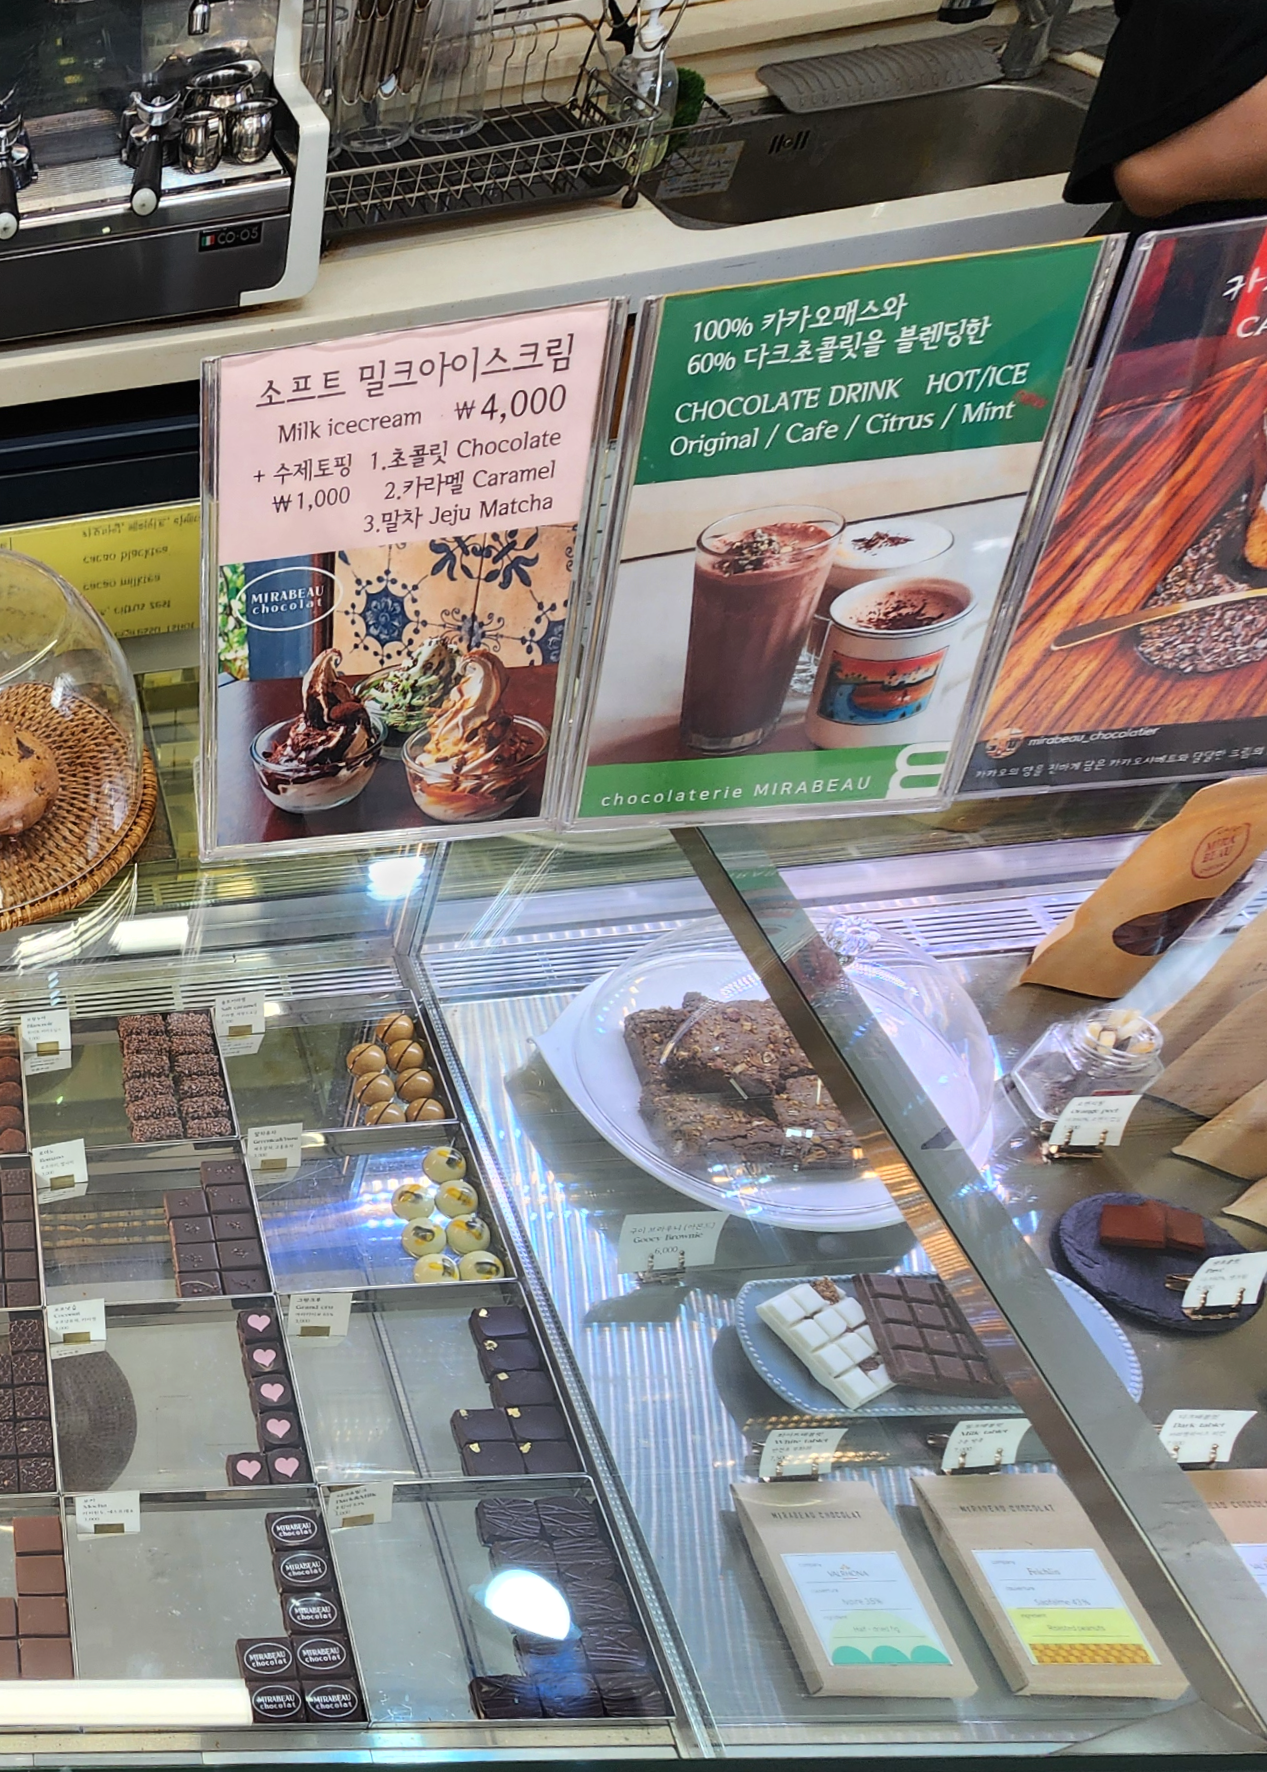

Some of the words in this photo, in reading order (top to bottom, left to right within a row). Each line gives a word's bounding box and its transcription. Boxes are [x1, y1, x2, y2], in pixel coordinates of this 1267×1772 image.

[693, 315, 753, 343] 100%
[761, 293, 908, 336] 카카오매스와
[687, 349, 736, 375] 60%
[744, 330, 886, 370] 다크초콜릿을
[895, 316, 992, 354] 블렌딩한
[255, 370, 346, 408] 소프트
[359, 333, 575, 399] 밀크아이스크림
[675, 388, 820, 424] CHOCOLATE
[829, 378, 903, 407] DRINK
[925, 362, 1030, 396] HOT/ICE
[454, 384, 567, 424] ₩4,000
[278, 420, 321, 444] Milk
[328, 409, 423, 437] icecream
[670, 426, 759, 458] Original
[785, 419, 839, 445] Cafe
[866, 411, 934, 434] Citrus
[962, 400, 1016, 424] Mint
[456, 429, 561, 460] Chocolate
[272, 453, 353, 485] 수제토핑
[473, 460, 556, 490] Caramel
[272, 485, 351, 514] ₩1,000
[428, 501, 472, 527] Jeju
[479, 493, 553, 519] Matcha
[251, 585, 324, 605] MIRABEAU
[252, 597, 323, 615] chocolat
[1028, 726, 1160, 746] mirabeau_chocolatier
[601, 786, 743, 807] chocolaterie
[754, 776, 872, 797] MIRABEAU
[819, 1511, 862, 1519] CHOCOLAT
[277, 1523, 311, 1532] MIRABEAU
[279, 1529, 312, 1537] chocolat
[285, 1561, 321, 1571] MIRABEAU
[288, 1567, 322, 1576] chocolat
[294, 1606, 331, 1615] MIRABEAU
[297, 1612, 332, 1621] chocolat
[249, 1651, 285, 1660] MIRABEAU
[303, 1647, 340, 1657] MIRABEAU
[305, 1654, 341, 1663] chocolat
[252, 1658, 287, 1667] chocolat
[257, 1694, 294, 1704] MIRABEAU
[260, 1701, 296, 1710] chocolat
[313, 1694, 351, 1704] MIRABEAU
[315, 1701, 352, 1710] chocolat
